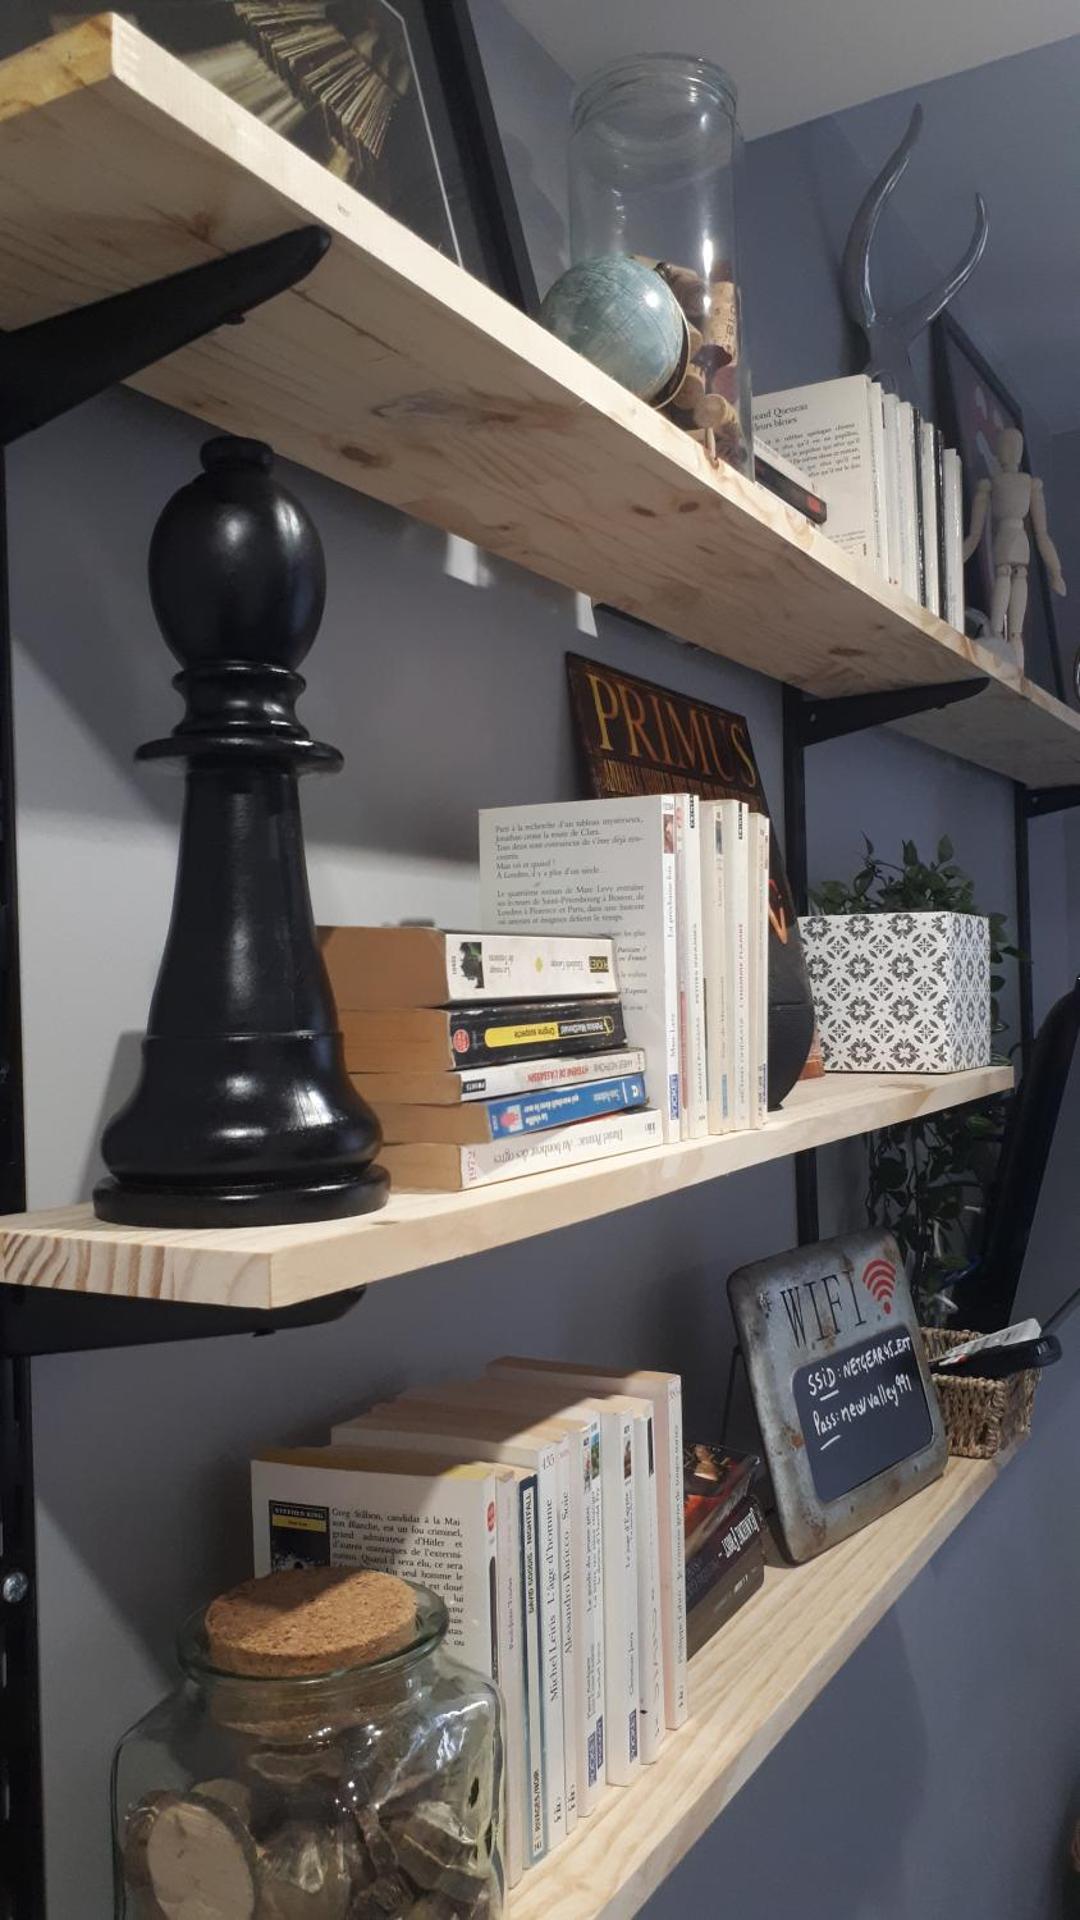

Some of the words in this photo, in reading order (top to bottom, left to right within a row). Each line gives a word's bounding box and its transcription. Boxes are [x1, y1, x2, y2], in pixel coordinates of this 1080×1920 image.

[586, 673, 757, 787] PRIMUS
[780, 1270, 867, 1349] WIFI
[397, 1525, 408, 1533] un
[412, 1525, 424, 1535] fou
[433, 1516, 440, 1525] la
[525, 1493, 534, 1545] NIGHTFALL
[411, 1548, 421, 1556] de
[546, 1615, 556, 1653] Leiris
[562, 1583, 572, 1654] Alessandro
[546, 1656, 559, 1702] Michel
